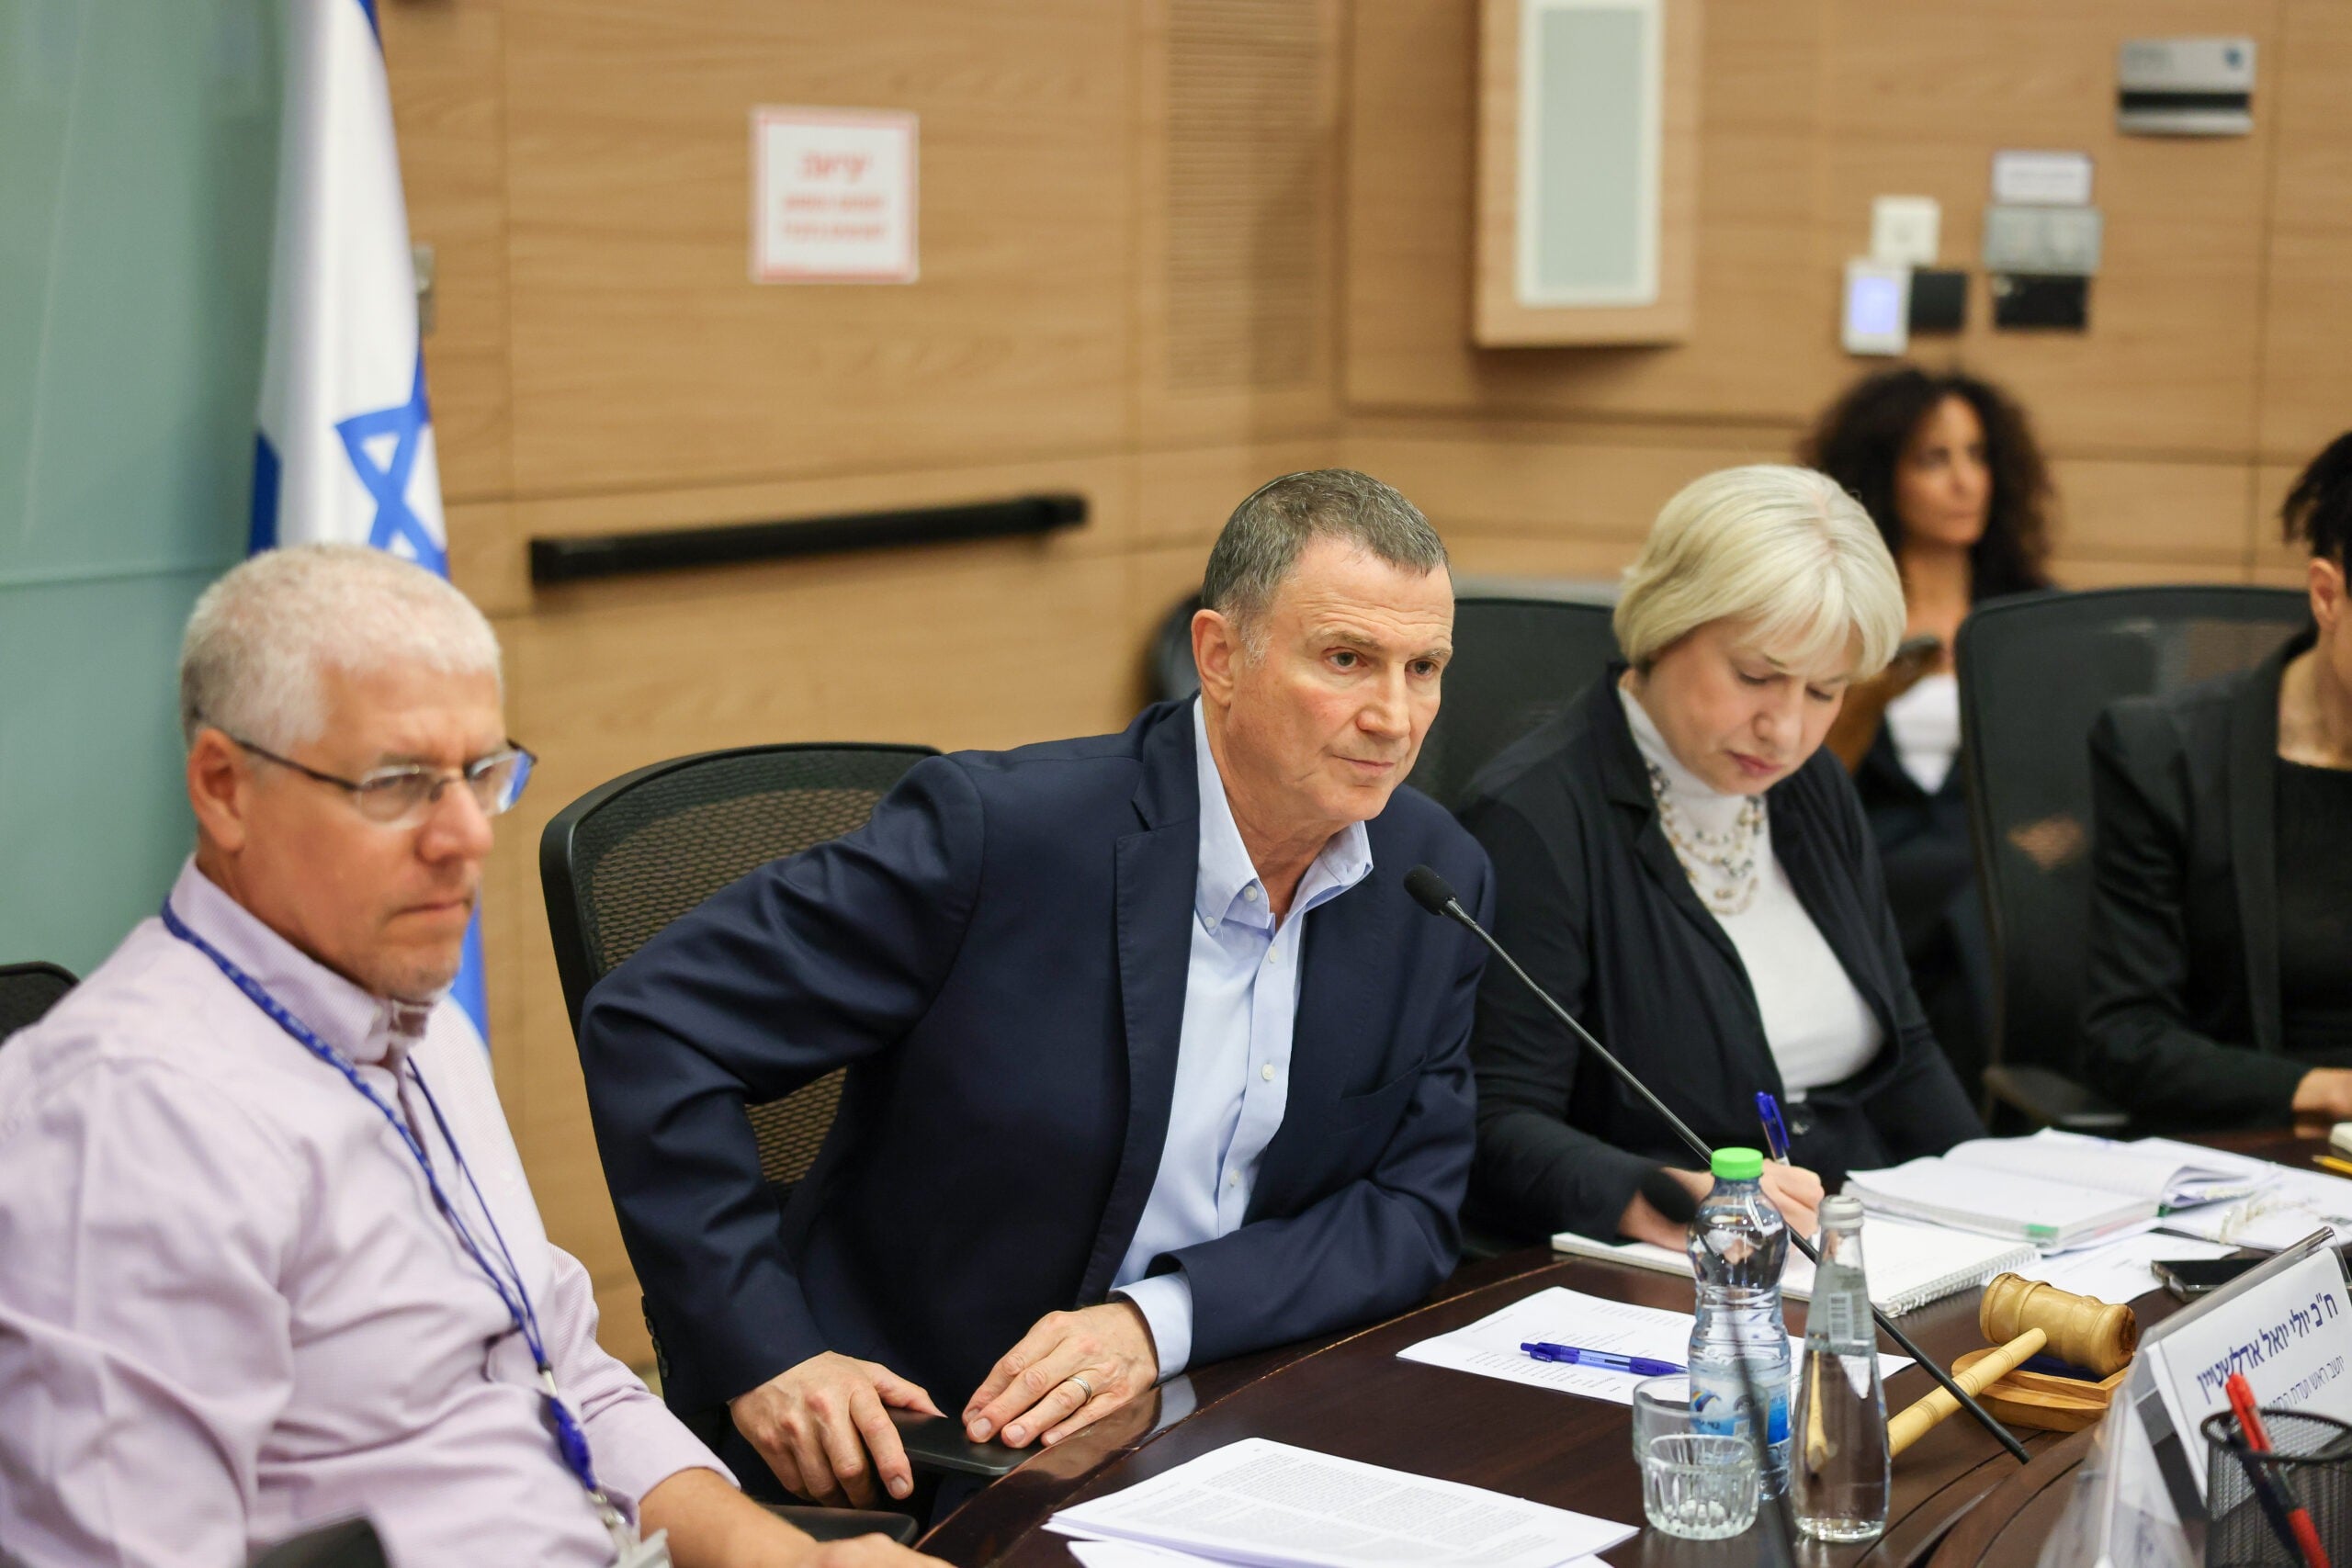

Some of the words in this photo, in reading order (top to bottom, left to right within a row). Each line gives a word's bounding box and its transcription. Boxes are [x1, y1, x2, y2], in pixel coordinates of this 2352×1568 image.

[2289, 1309, 2311, 1337] יולי
[2310, 1292, 2338, 1327] ח"כ
[2258, 1323, 2290, 1358] יואל
[2197, 1339, 2265, 1404] אדלשטיין
[2308, 1367, 2329, 1390] ראש
[2290, 1379, 2312, 1404] ועדת
